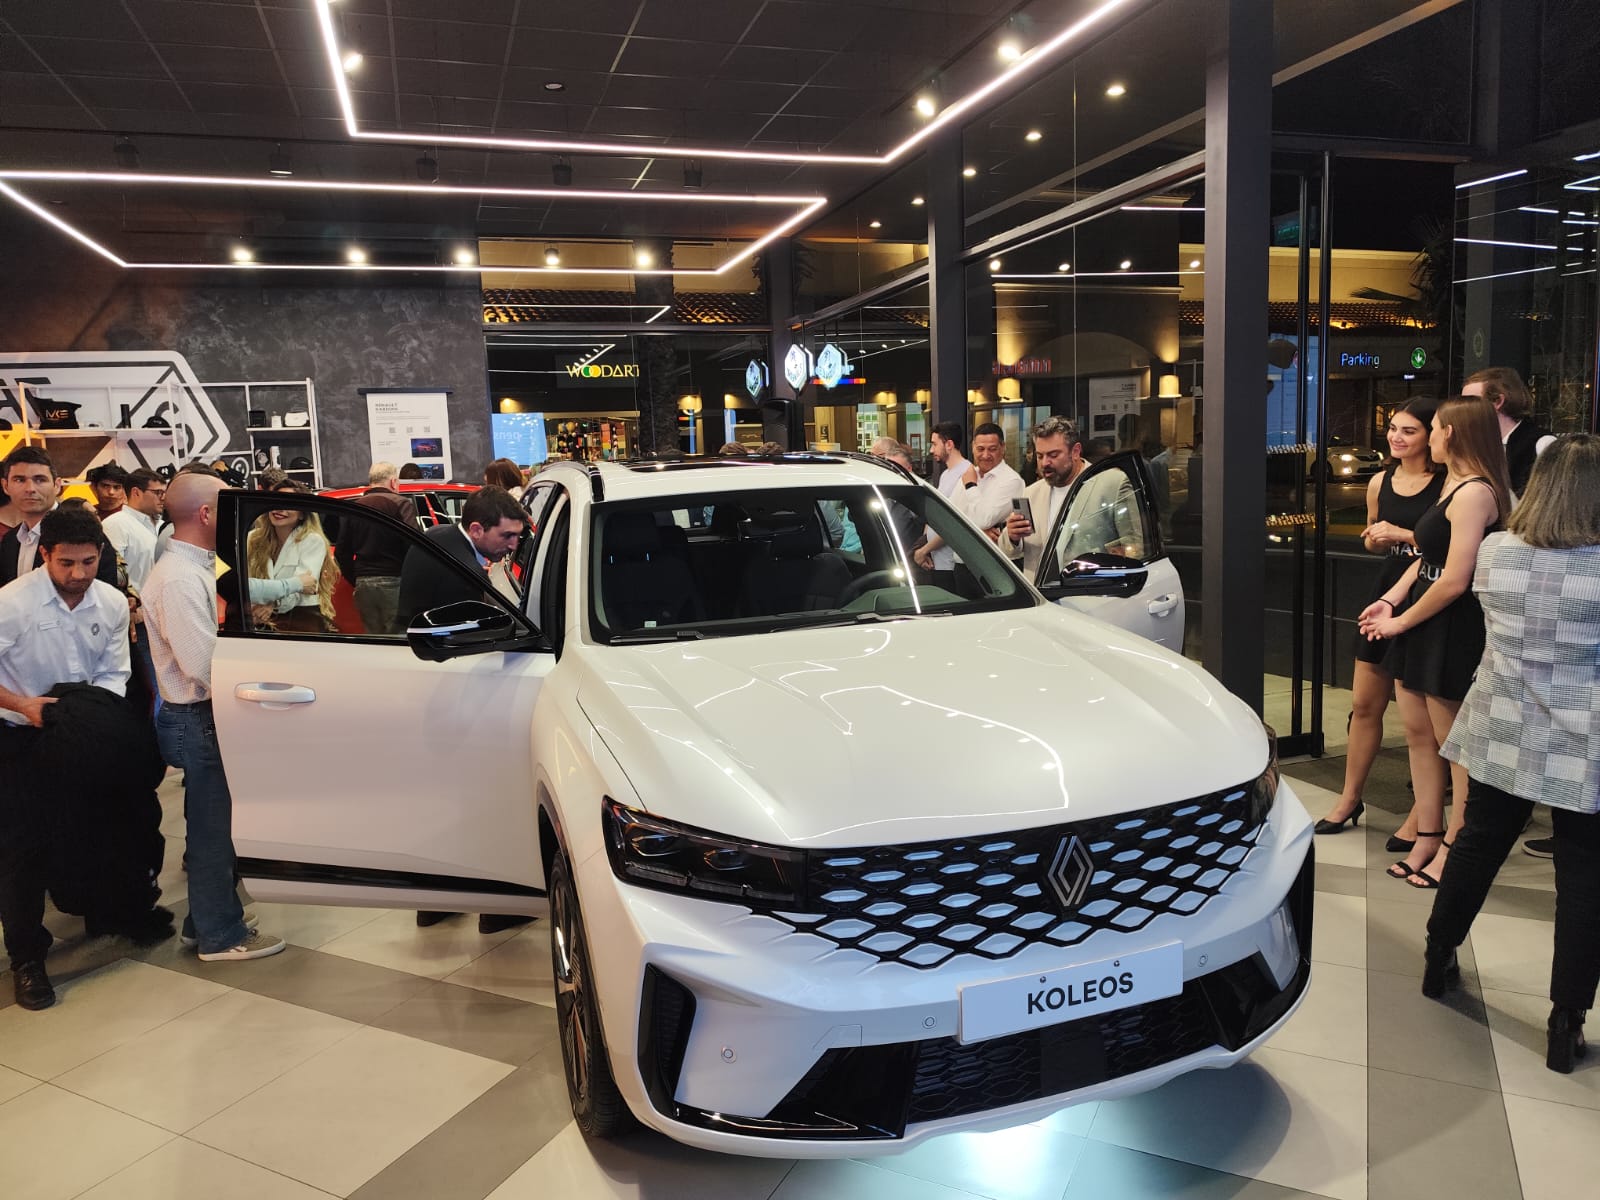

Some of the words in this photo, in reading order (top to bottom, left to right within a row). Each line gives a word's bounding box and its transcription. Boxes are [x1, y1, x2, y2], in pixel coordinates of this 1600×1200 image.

[1341, 353, 1380, 369] Parking
[1419, 562, 1445, 581] AU
[1027, 971, 1134, 1015] KOLEOS
